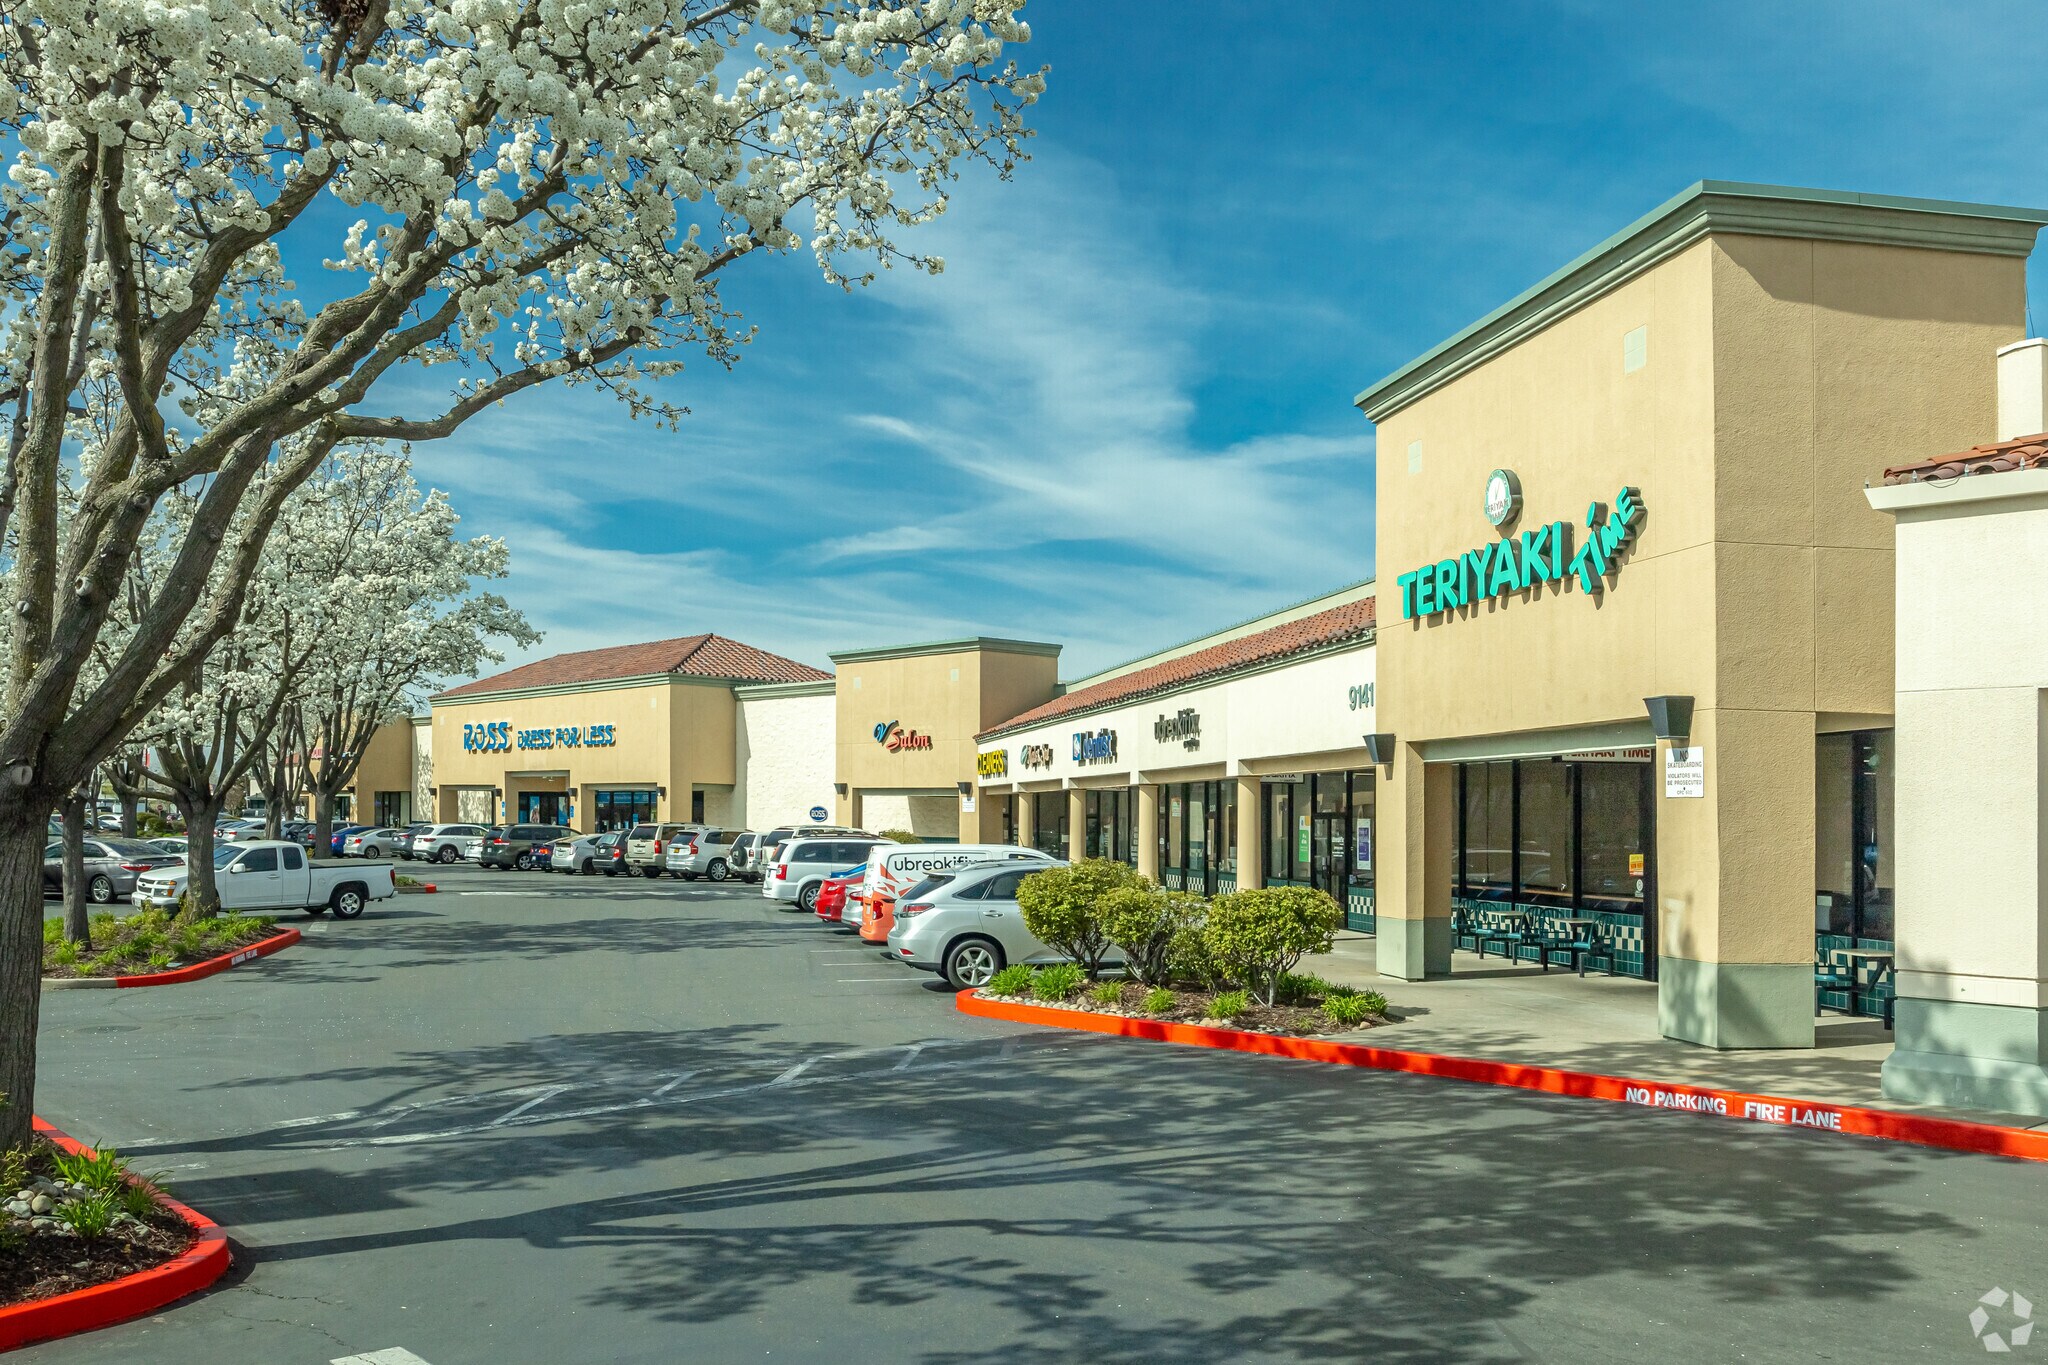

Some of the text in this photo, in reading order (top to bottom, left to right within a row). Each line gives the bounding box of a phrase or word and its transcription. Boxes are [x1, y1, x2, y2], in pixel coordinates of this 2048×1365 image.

[1397, 521, 1563, 620] TERIYAKI
[1349, 682, 1374, 711] 9141
[464, 721, 614, 750] ROSS DRESS FOR LESS
[886, 728, 930, 751] Salon
[977, 748, 1006, 776] CLEANERS
[1667, 761, 1702, 769] SKATEBOARDING
[1679, 750, 1689, 761] NO
[811, 809, 826, 818] ROSS
[1626, 1086, 1728, 1115] NO PARKING
[1744, 1101, 1843, 1130] FIRE LANE
